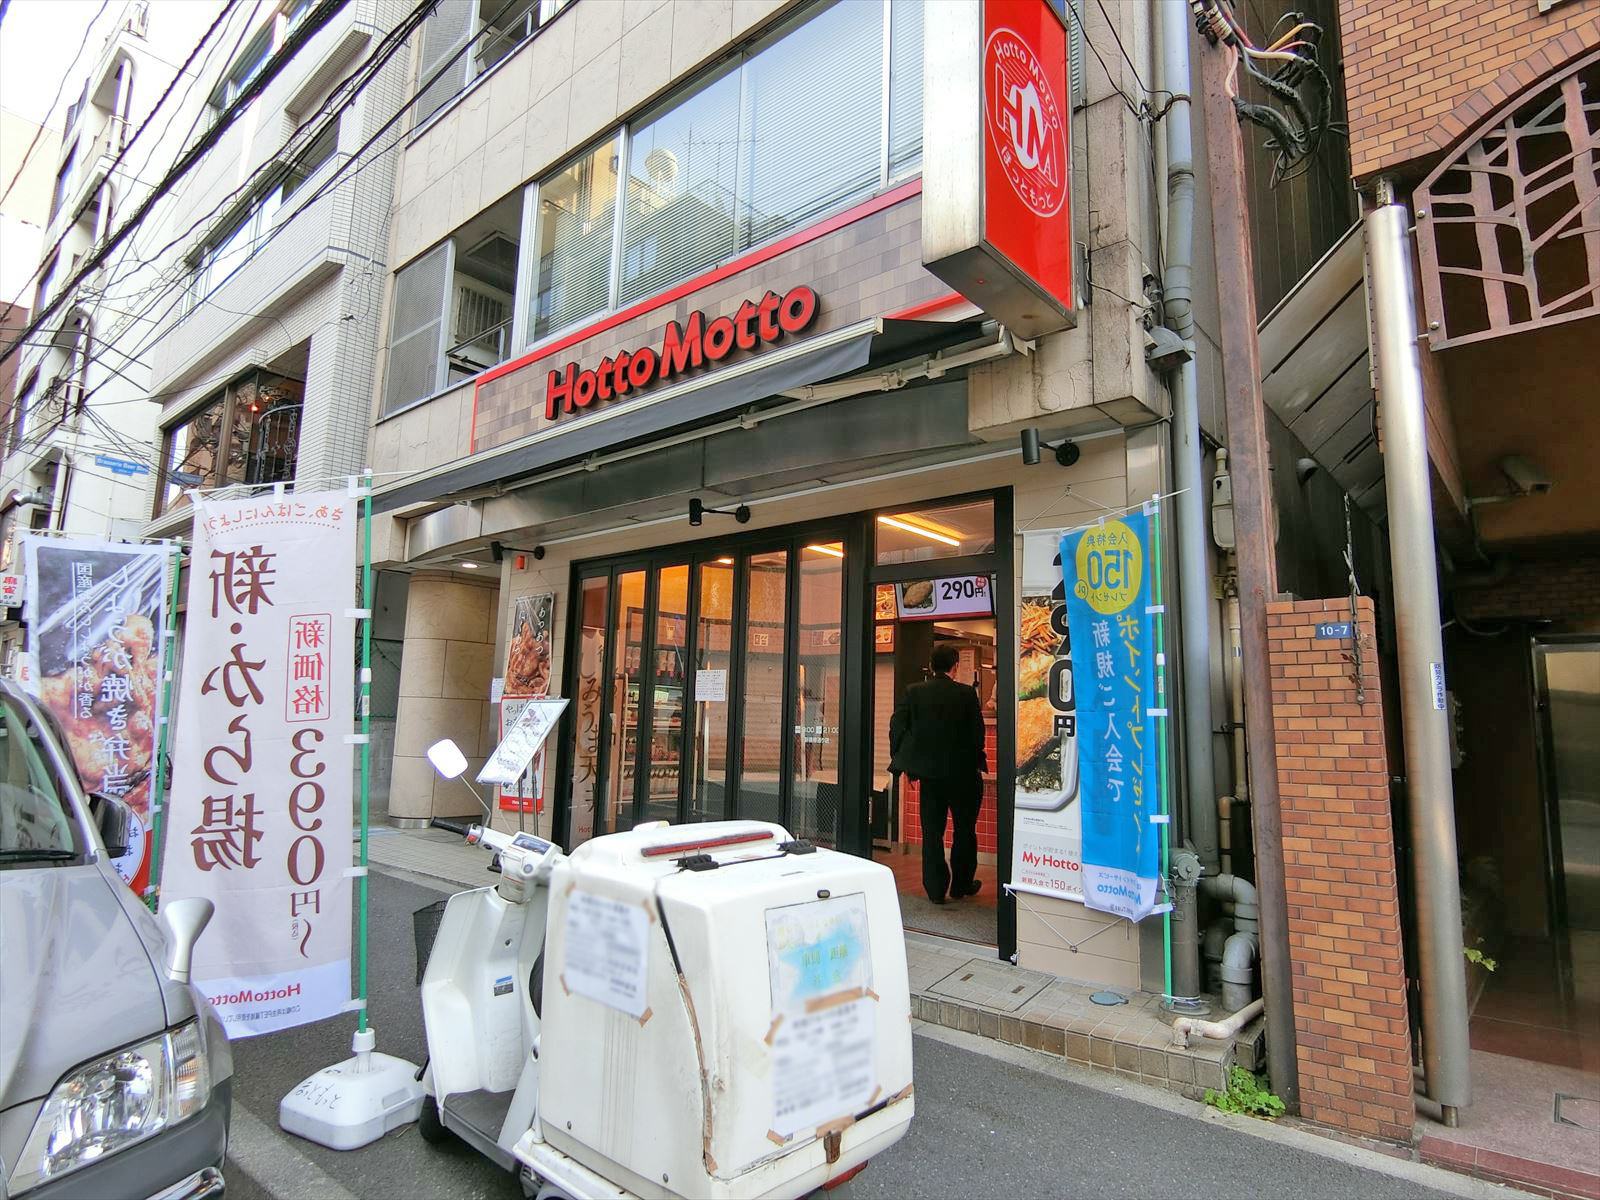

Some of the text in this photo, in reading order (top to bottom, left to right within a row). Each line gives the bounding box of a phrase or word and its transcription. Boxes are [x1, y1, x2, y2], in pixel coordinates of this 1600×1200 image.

[1001, 145, 1053, 210] ほっともっと
[1320, 625, 1348, 637] 10-7
[1022, 850, 1083, 873] My Hotto
